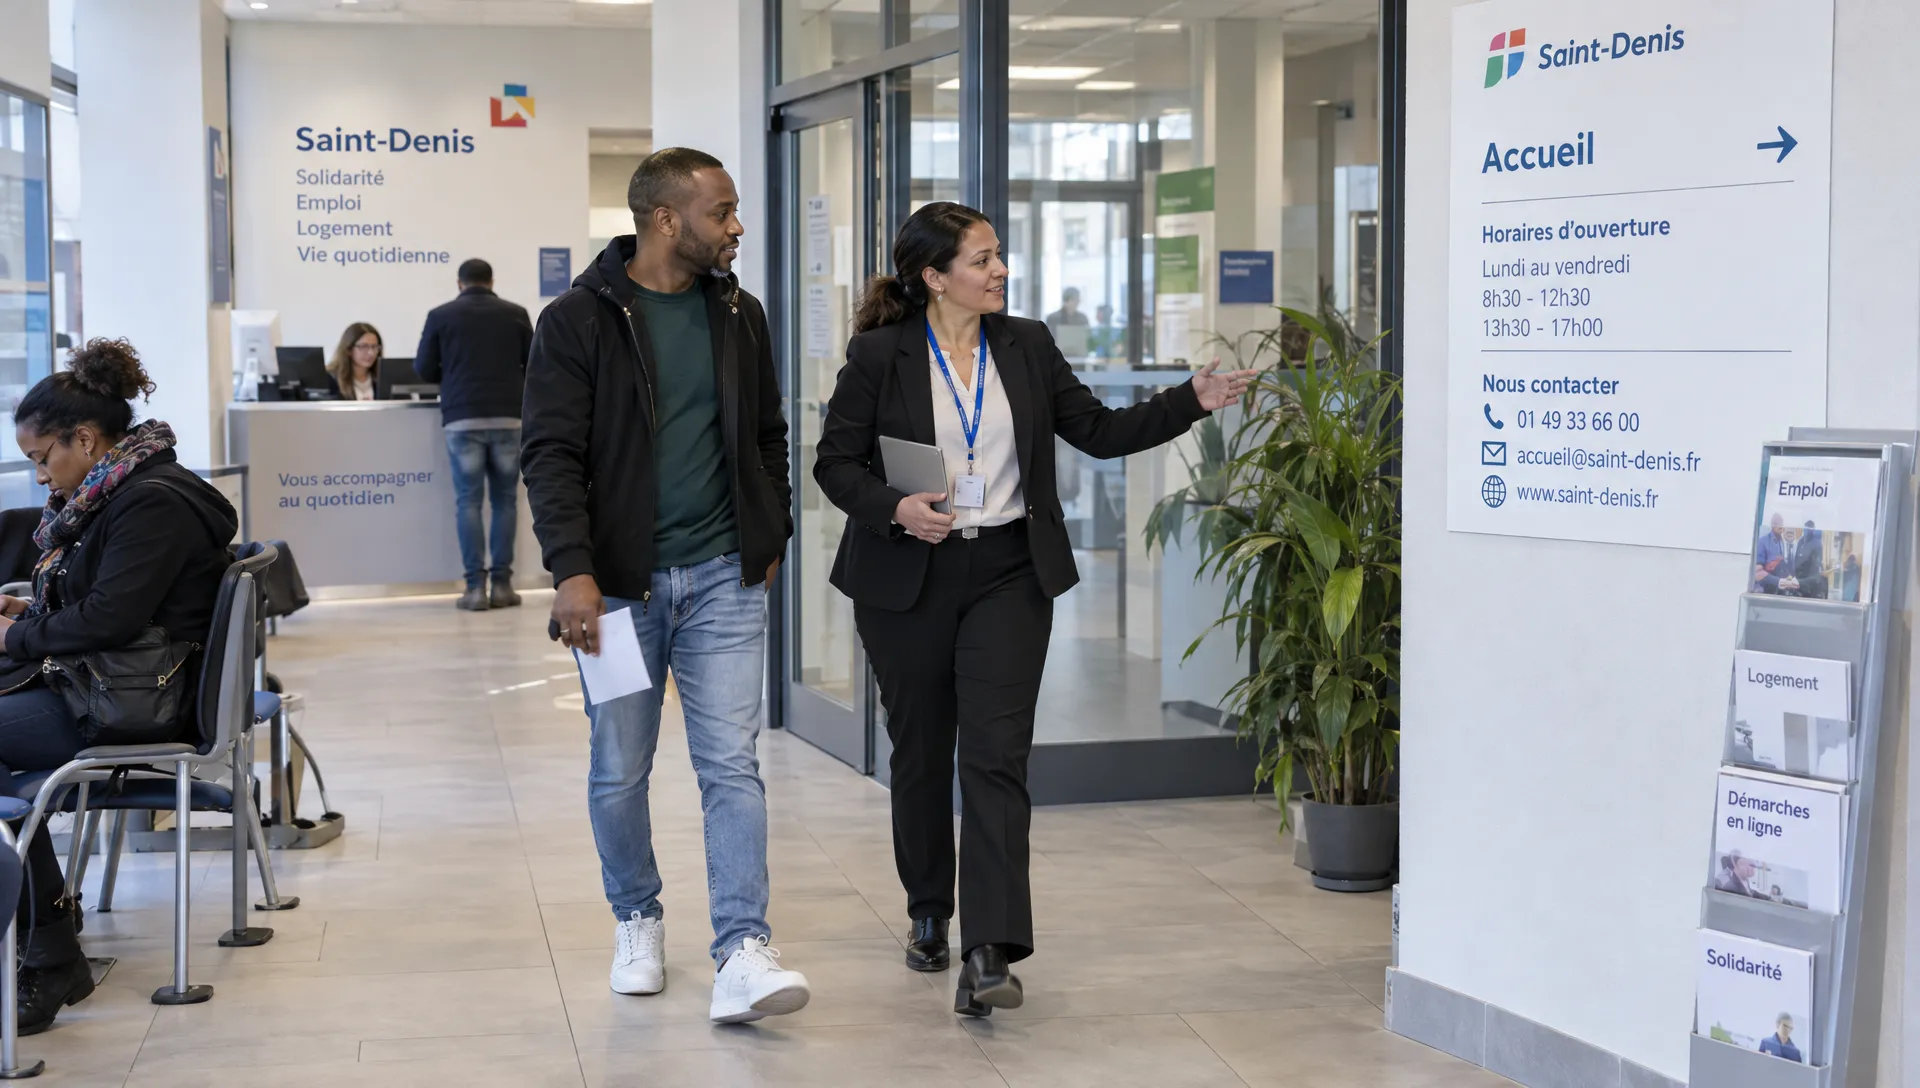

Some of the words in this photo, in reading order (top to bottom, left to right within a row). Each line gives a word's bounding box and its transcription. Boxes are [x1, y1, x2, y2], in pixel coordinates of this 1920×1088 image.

[1537, 23, 1685, 69] Saint-Denis
[295, 126, 475, 153] Saint-Denis
[1481, 130, 1594, 173] Accueil
[296, 168, 385, 186] Solidarité
[296, 193, 362, 214] Emploi
[297, 219, 393, 240] Logement
[1482, 222, 1554, 243] Horaires
[296, 245, 328, 262] Vie
[333, 246, 451, 266] quotidienne
[1482, 257, 1525, 277] Lundi
[1530, 262, 1550, 276] au
[1554, 253, 1630, 275] vendredi
[1482, 288, 1521, 307] 8h30
[1540, 287, 1591, 306] 12h30
[1483, 318, 1531, 336] 13h30
[1551, 317, 1603, 336] 17h00
[1483, 373, 1526, 392] Nous
[1530, 376, 1620, 394] contacter
[1517, 409, 1534, 428] 01
[1541, 410, 1562, 429] 49
[1566, 410, 1587, 430] 33
[1591, 411, 1613, 431] 66
[1618, 412, 1640, 432] 00
[1517, 446, 1702, 471] accueil@saint-denis.fr
[277, 472, 319, 487] Vous
[323, 471, 434, 487] accompagner
[278, 496, 301, 508] au
[305, 489, 395, 510] quotidien
[1516, 484, 1659, 508] www.saint-denis.fr
[1778, 480, 1829, 500] Emploi
[1747, 667, 1819, 690] Logement
[1728, 790, 1810, 820] Démarches
[1726, 815, 1744, 829] en
[1747, 815, 1783, 837] ligne
[1706, 947, 1783, 981] Solidarité
